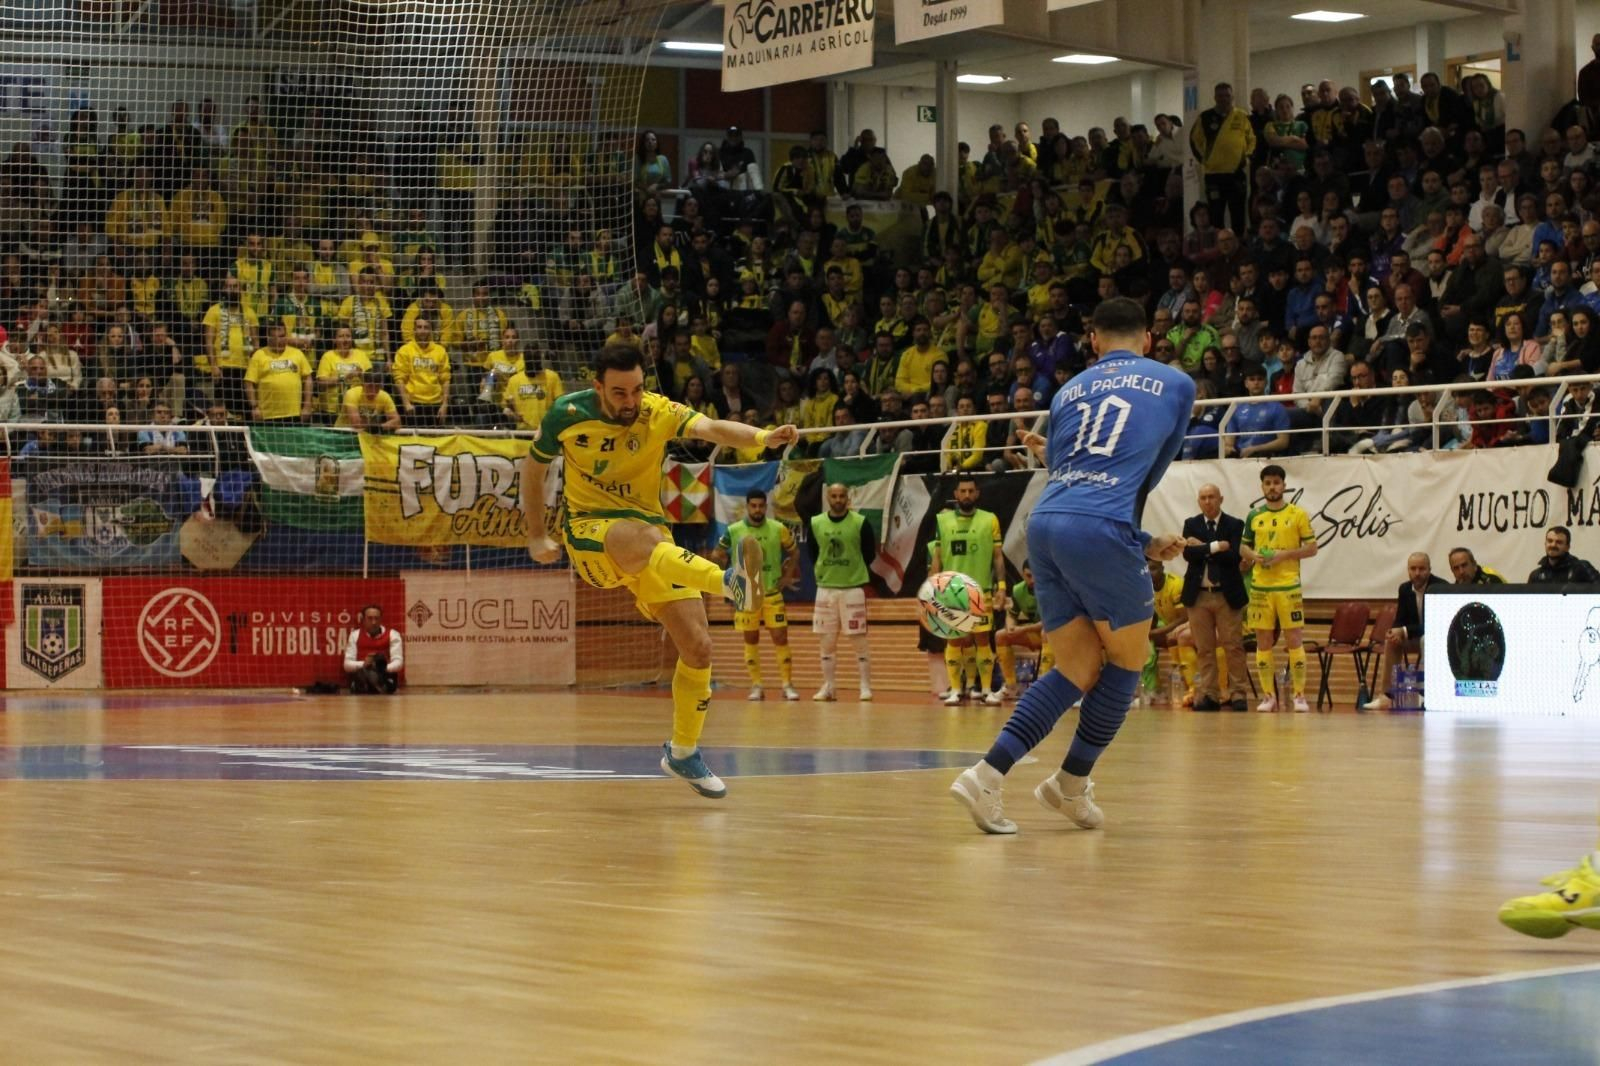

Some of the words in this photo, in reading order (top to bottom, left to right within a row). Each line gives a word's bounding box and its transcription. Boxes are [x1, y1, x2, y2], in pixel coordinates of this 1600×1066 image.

[754, 0, 873, 43] CARRETERO
[923, 9, 948, 27] Desde
[949, 6, 967, 21] 1999
[727, 44, 802, 68] MAQUINARIA
[810, 29, 873, 52] AGRÍCOL
[1060, 384, 1087, 407] POL
[1090, 374, 1164, 396] PACHECO
[1068, 394, 1132, 457] 10
[600, 438, 616, 452] 21
[1456, 488, 1550, 533] MUCHO
[34, 594, 74, 605] ALBALI
[438, 599, 570, 630] UCLM
[164, 618, 195, 631] RF
[252, 622, 321, 656] FÚTBOL
[326, 626, 357, 656] SA
[405, 635, 464, 643] UNIVERSIDAD
[465, 635, 477, 643] DE
[532, 635, 569, 643] MANCHA
[164, 635, 195, 648] EF
